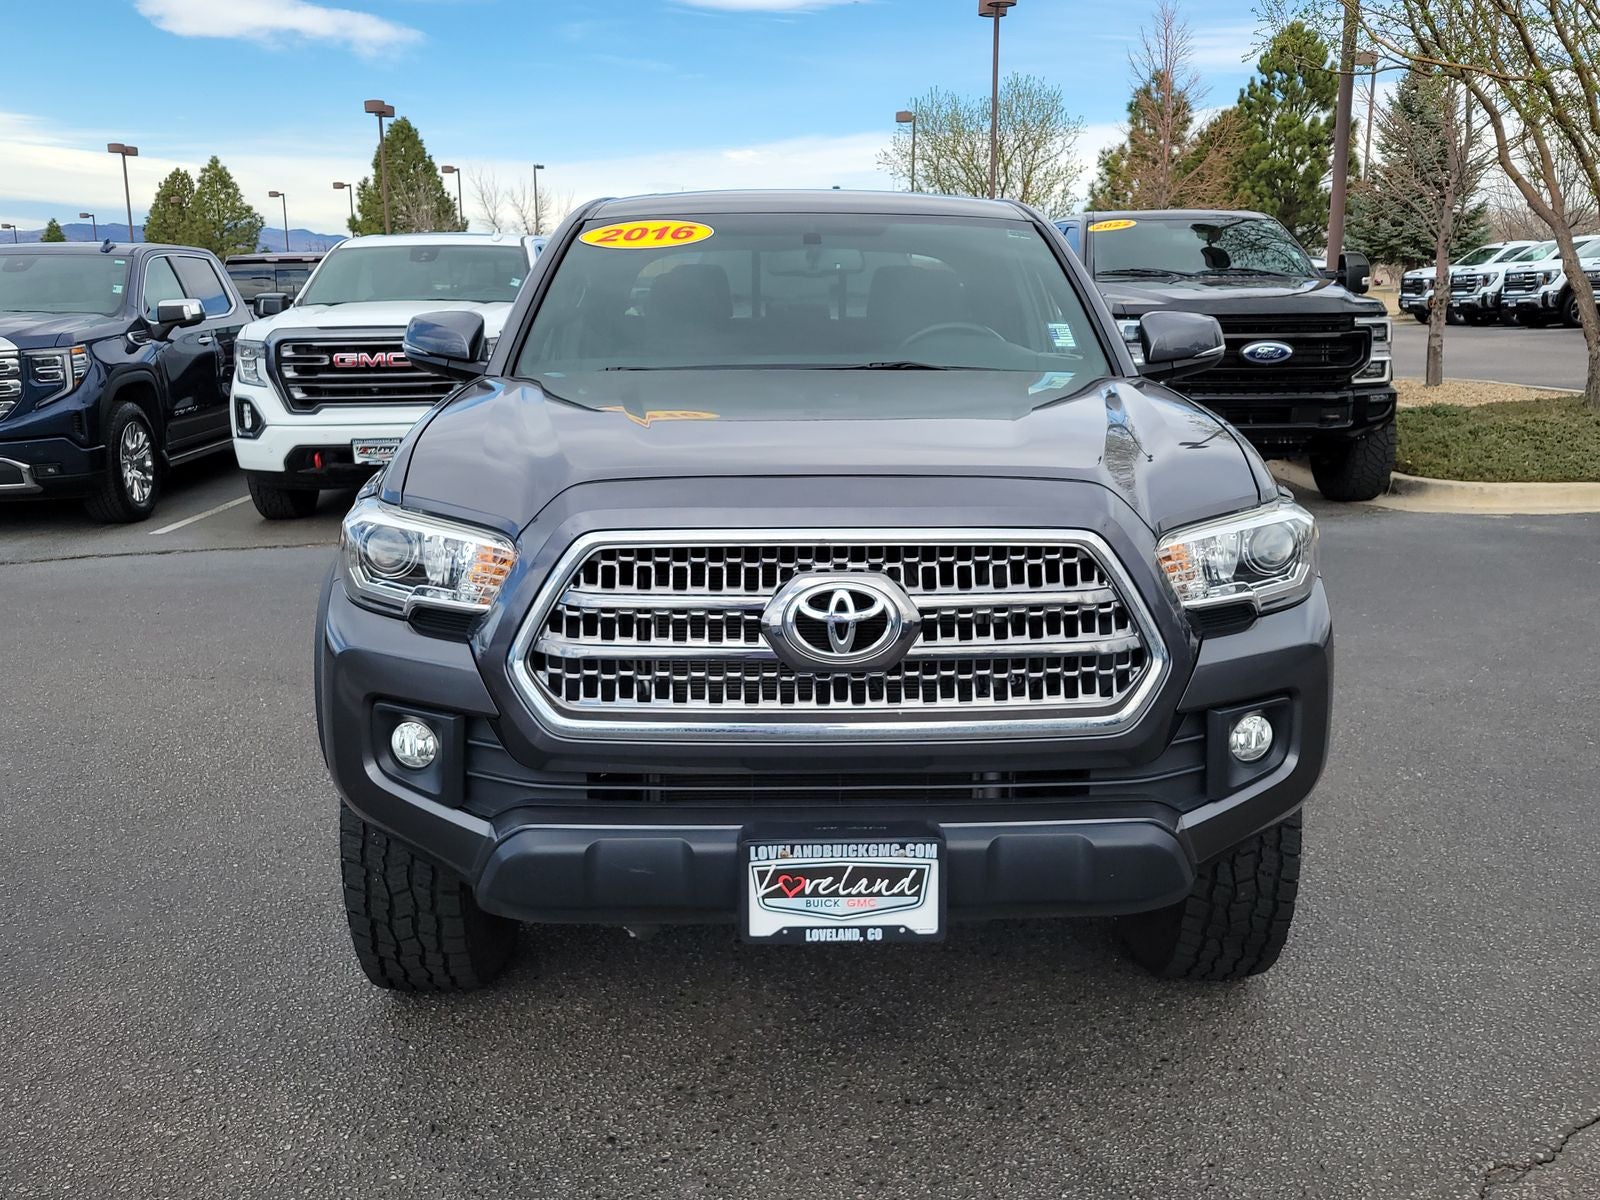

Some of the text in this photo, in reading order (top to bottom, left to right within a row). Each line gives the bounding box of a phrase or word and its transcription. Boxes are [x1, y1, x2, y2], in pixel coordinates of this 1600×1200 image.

[595, 225, 697, 243] 2016
[1255, 345, 1282, 359] Ford
[333, 352, 412, 368] GMC
[750, 842, 938, 861] LOVELANDBUICKGMCCOM
[805, 898, 877, 908] BUICK GMC
[805, 928, 883, 942] LOVELAND, CO
